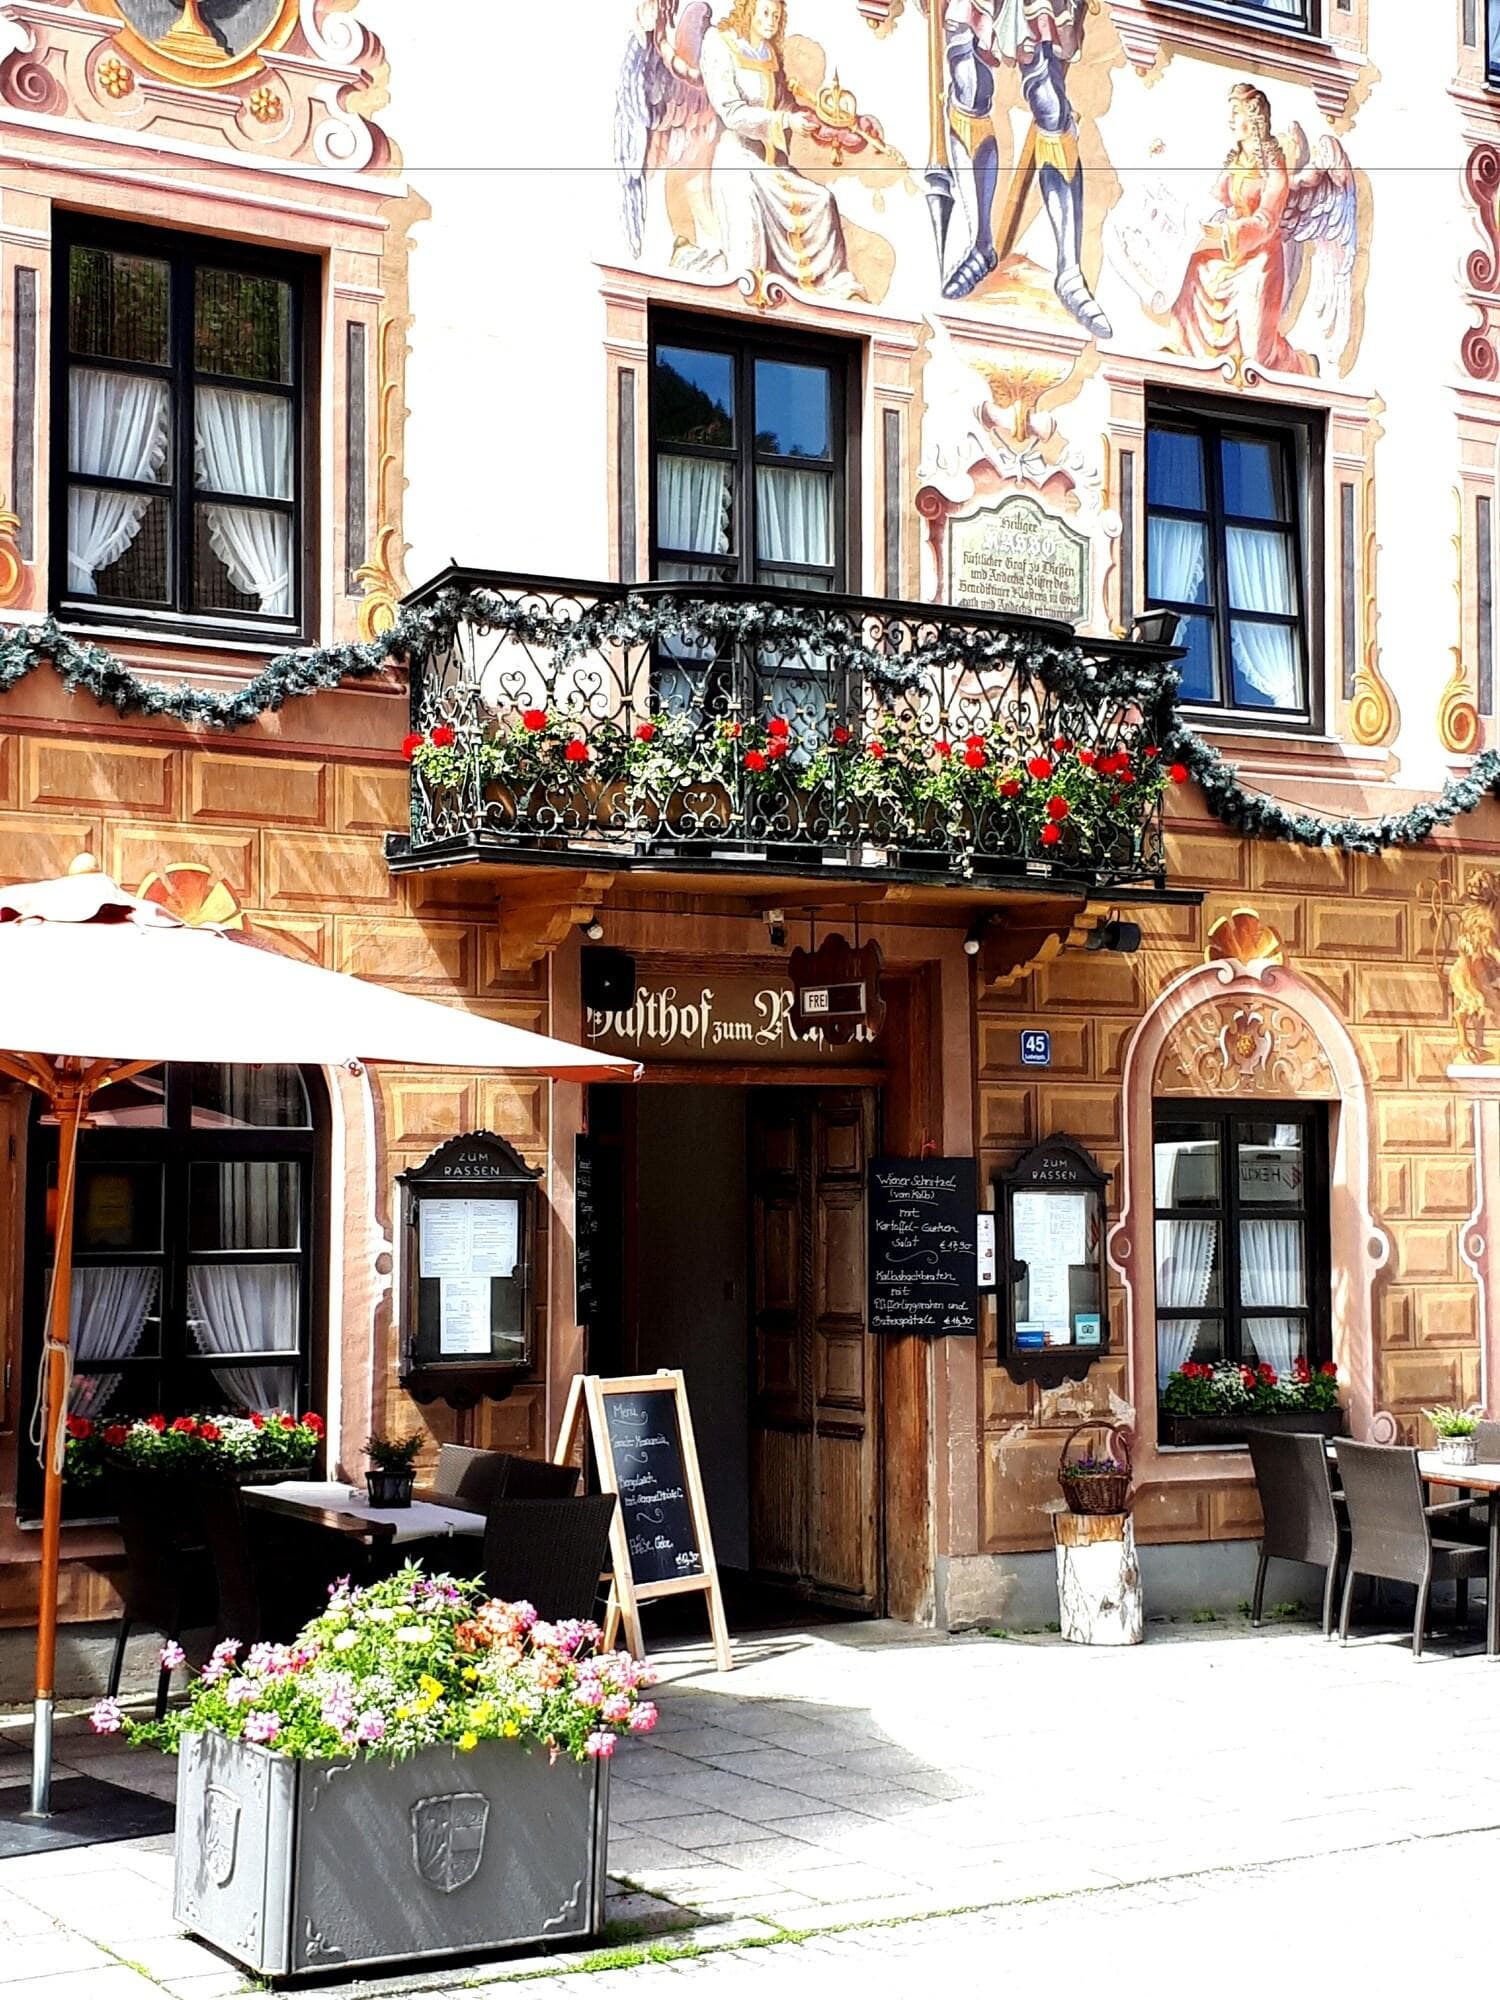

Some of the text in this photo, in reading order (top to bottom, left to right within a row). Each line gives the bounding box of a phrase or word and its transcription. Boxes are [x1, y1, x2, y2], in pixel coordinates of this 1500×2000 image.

[1000, 512, 1038, 534] Heiliger
[1004, 557, 1027, 574] Graf
[1028, 561, 1039, 573] zu
[970, 568, 987, 580] und
[989, 568, 1025, 586] Andechs
[1053, 578, 1070, 591] des
[958, 579, 1010, 598] Benediktiner
[808, 994, 828, 1009] FREI
[712, 1021, 754, 1045] zum
[1026, 1036, 1045, 1052] 45
[459, 1152, 488, 1162] ZUM
[1043, 1158, 1068, 1168] ZUM
[444, 1166, 500, 1176] RASSEN
[1032, 1170, 1077, 1180] RASSEN
[876, 1173, 957, 1188] Wiener Schnitzel
[898, 1207, 920, 1218] mit
[921, 1222, 959, 1233] Gurken
[890, 1286, 911, 1297] mit
[948, 1301, 969, 1311] und
